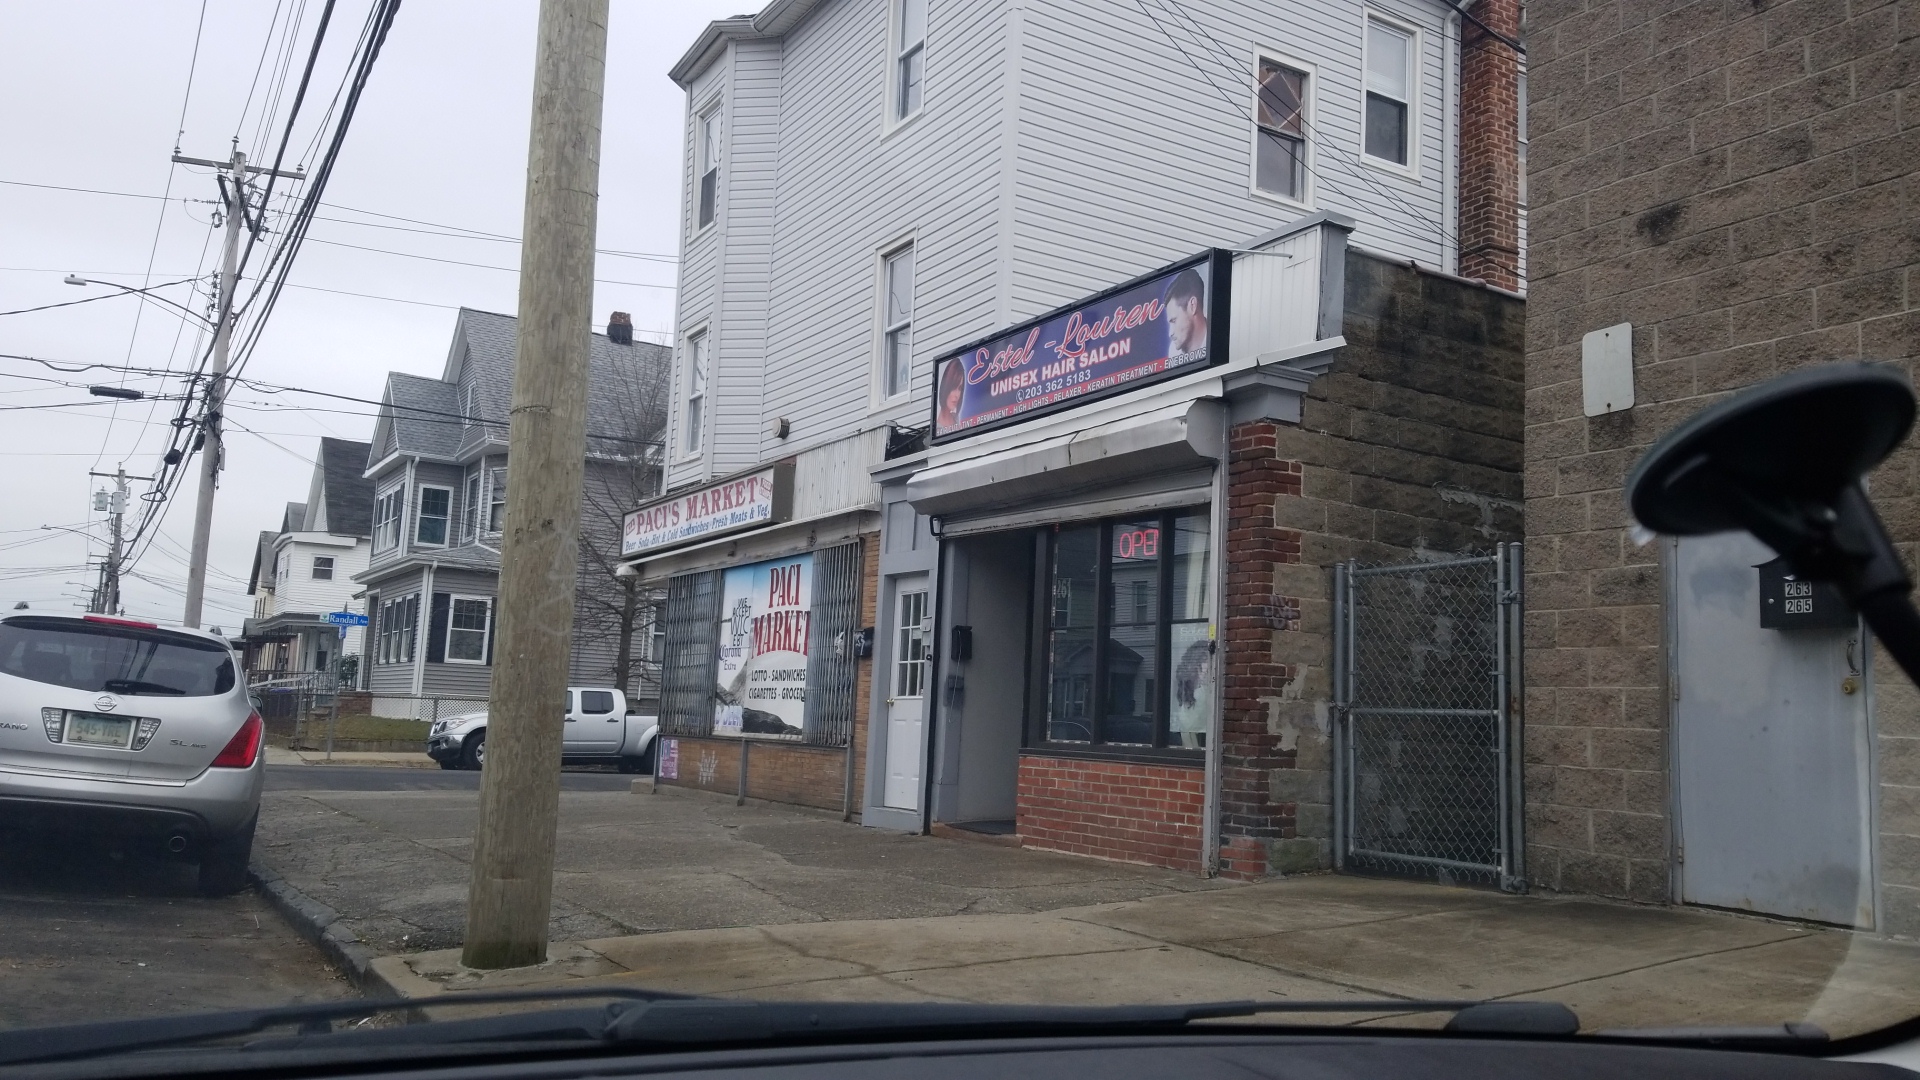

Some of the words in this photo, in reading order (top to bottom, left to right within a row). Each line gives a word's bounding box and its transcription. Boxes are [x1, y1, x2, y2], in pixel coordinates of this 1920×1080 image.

[967, 326, 1040, 385] Estel
[990, 369, 1038, 397] UNISEX
[1041, 356, 1076, 381] HAIR
[1079, 337, 1131, 368] SALON
[962, 418, 973, 429] TINT
[977, 408, 1008, 423] PERMANENT
[1013, 403, 1027, 415] HIGH
[1028, 396, 1049, 409] LIGHTS
[1053, 386, 1082, 402] RELAXER
[1087, 376, 1115, 392] KERATIN
[1117, 363, 1158, 382] TREATMENT
[1164, 347, 1207, 369] EYEBROWS
[1025, 384, 1042, 400] 203
[1045, 378, 1063, 394] 362
[1066, 369, 1091, 387] 5183
[636, 501, 680, 535] PACI'S
[685, 476, 759, 522] MARKET
[625, 540, 637, 551] Beer
[638, 536, 649, 549] Soda
[667, 527, 678, 541] Cold
[680, 520, 709, 538] Sandwiches
[711, 514, 728, 529] Fresh
[729, 510, 748, 525] Meats
[749, 506, 755, 520] &
[768, 563, 802, 609] PACI
[1786, 583, 1811, 596] 263
[733, 606, 752, 618] ACCEPT
[1787, 600, 1811, 613] 265
[330, 614, 358, 624] Randall
[730, 616, 749, 635] WIC
[733, 634, 744, 647] EBT
[719, 644, 741, 661] Corona
[723, 660, 737, 671] Extra
[751, 669, 768, 682] LOTTO
[771, 668, 806, 682] SANDWICHES
[748, 687, 777, 700] CIGARETTES
[169, 739, 187, 747] SL
